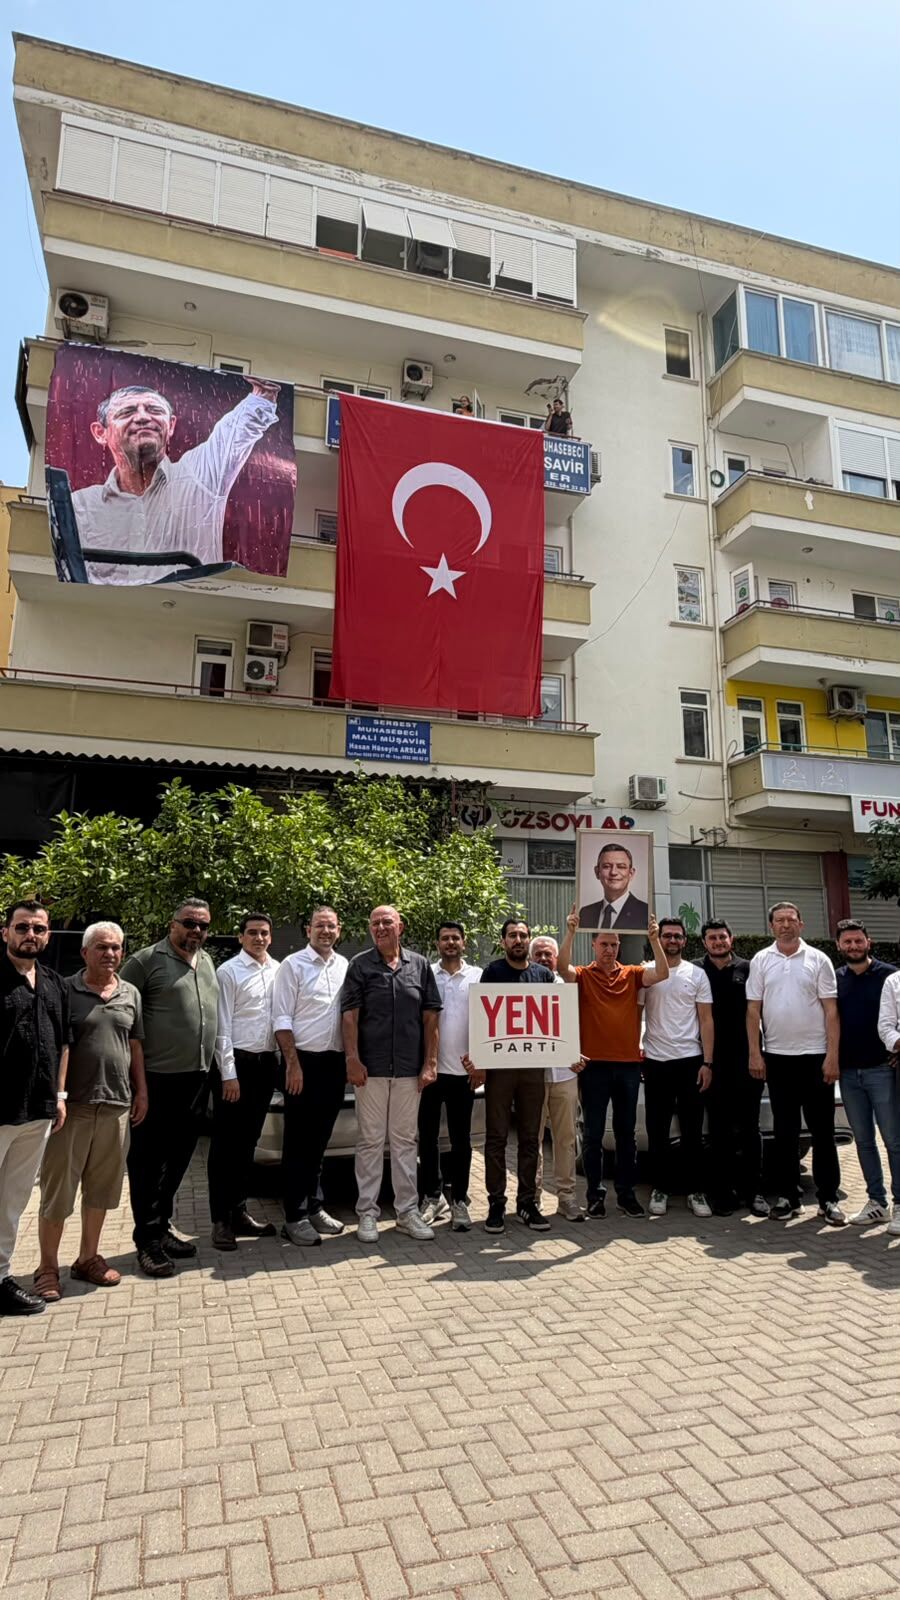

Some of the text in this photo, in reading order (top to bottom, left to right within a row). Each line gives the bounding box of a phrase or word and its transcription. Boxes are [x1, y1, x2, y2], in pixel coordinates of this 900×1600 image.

[543, 439, 585, 459] UHASEBECİ
[544, 456, 584, 475] ŞAVİR
[550, 472, 571, 483] ER
[373, 719, 418, 729] SERBEST
[357, 726, 419, 737] MUHASEBECİ
[351, 733, 426, 746] MALİ MÜŞAVİR
[349, 743, 427, 755] Hasan Hüseyin ARSLAN
